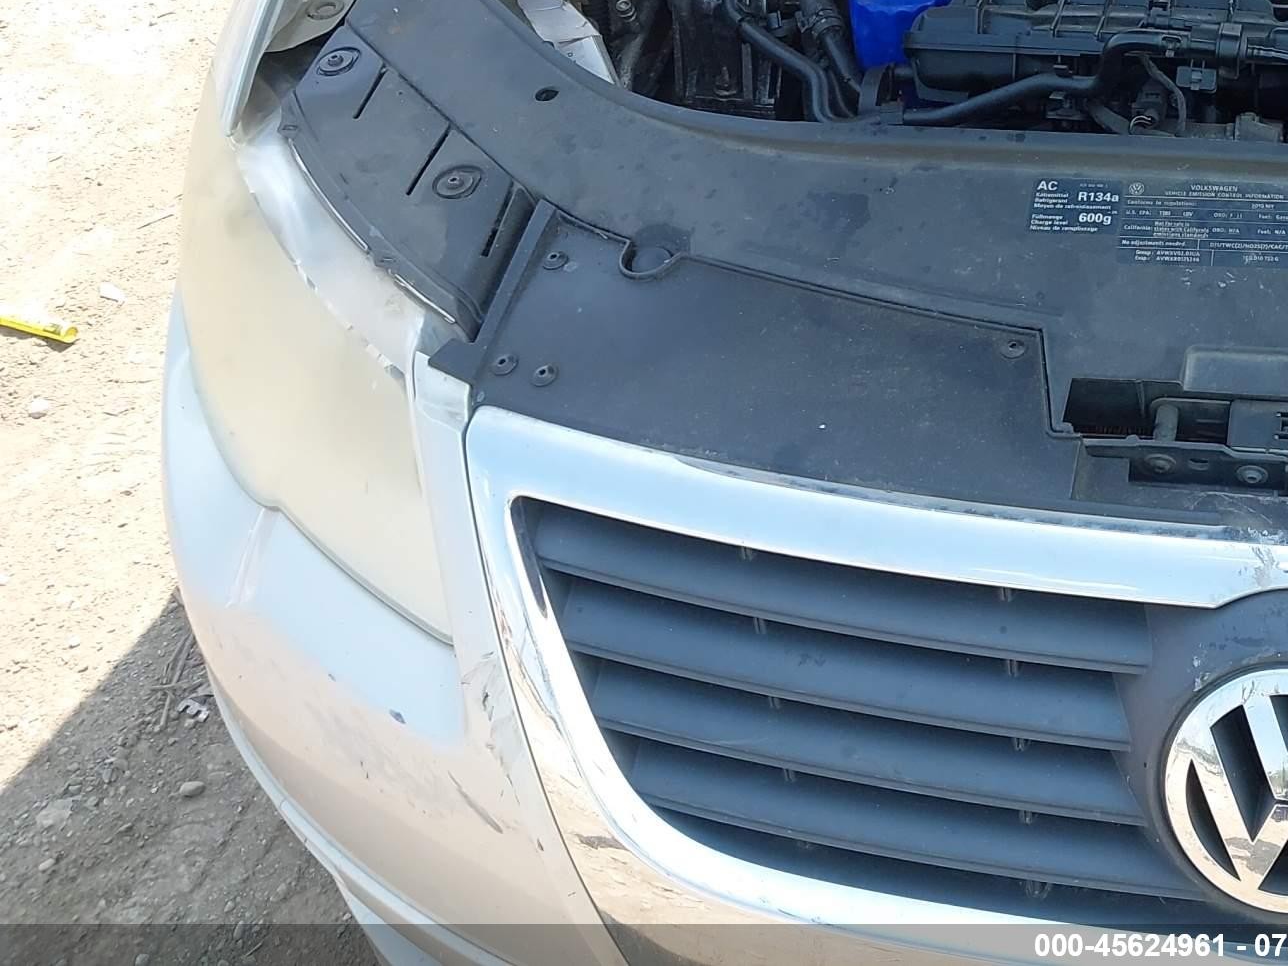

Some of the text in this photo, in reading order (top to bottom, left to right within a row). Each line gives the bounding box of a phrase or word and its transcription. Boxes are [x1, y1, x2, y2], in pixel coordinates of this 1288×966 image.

[1036, 180, 1058, 191] AC
[1190, 184, 1238, 192] VOLKSWAGEN
[1077, 191, 1120, 202] R134a
[1078, 213, 1112, 225] 600g
